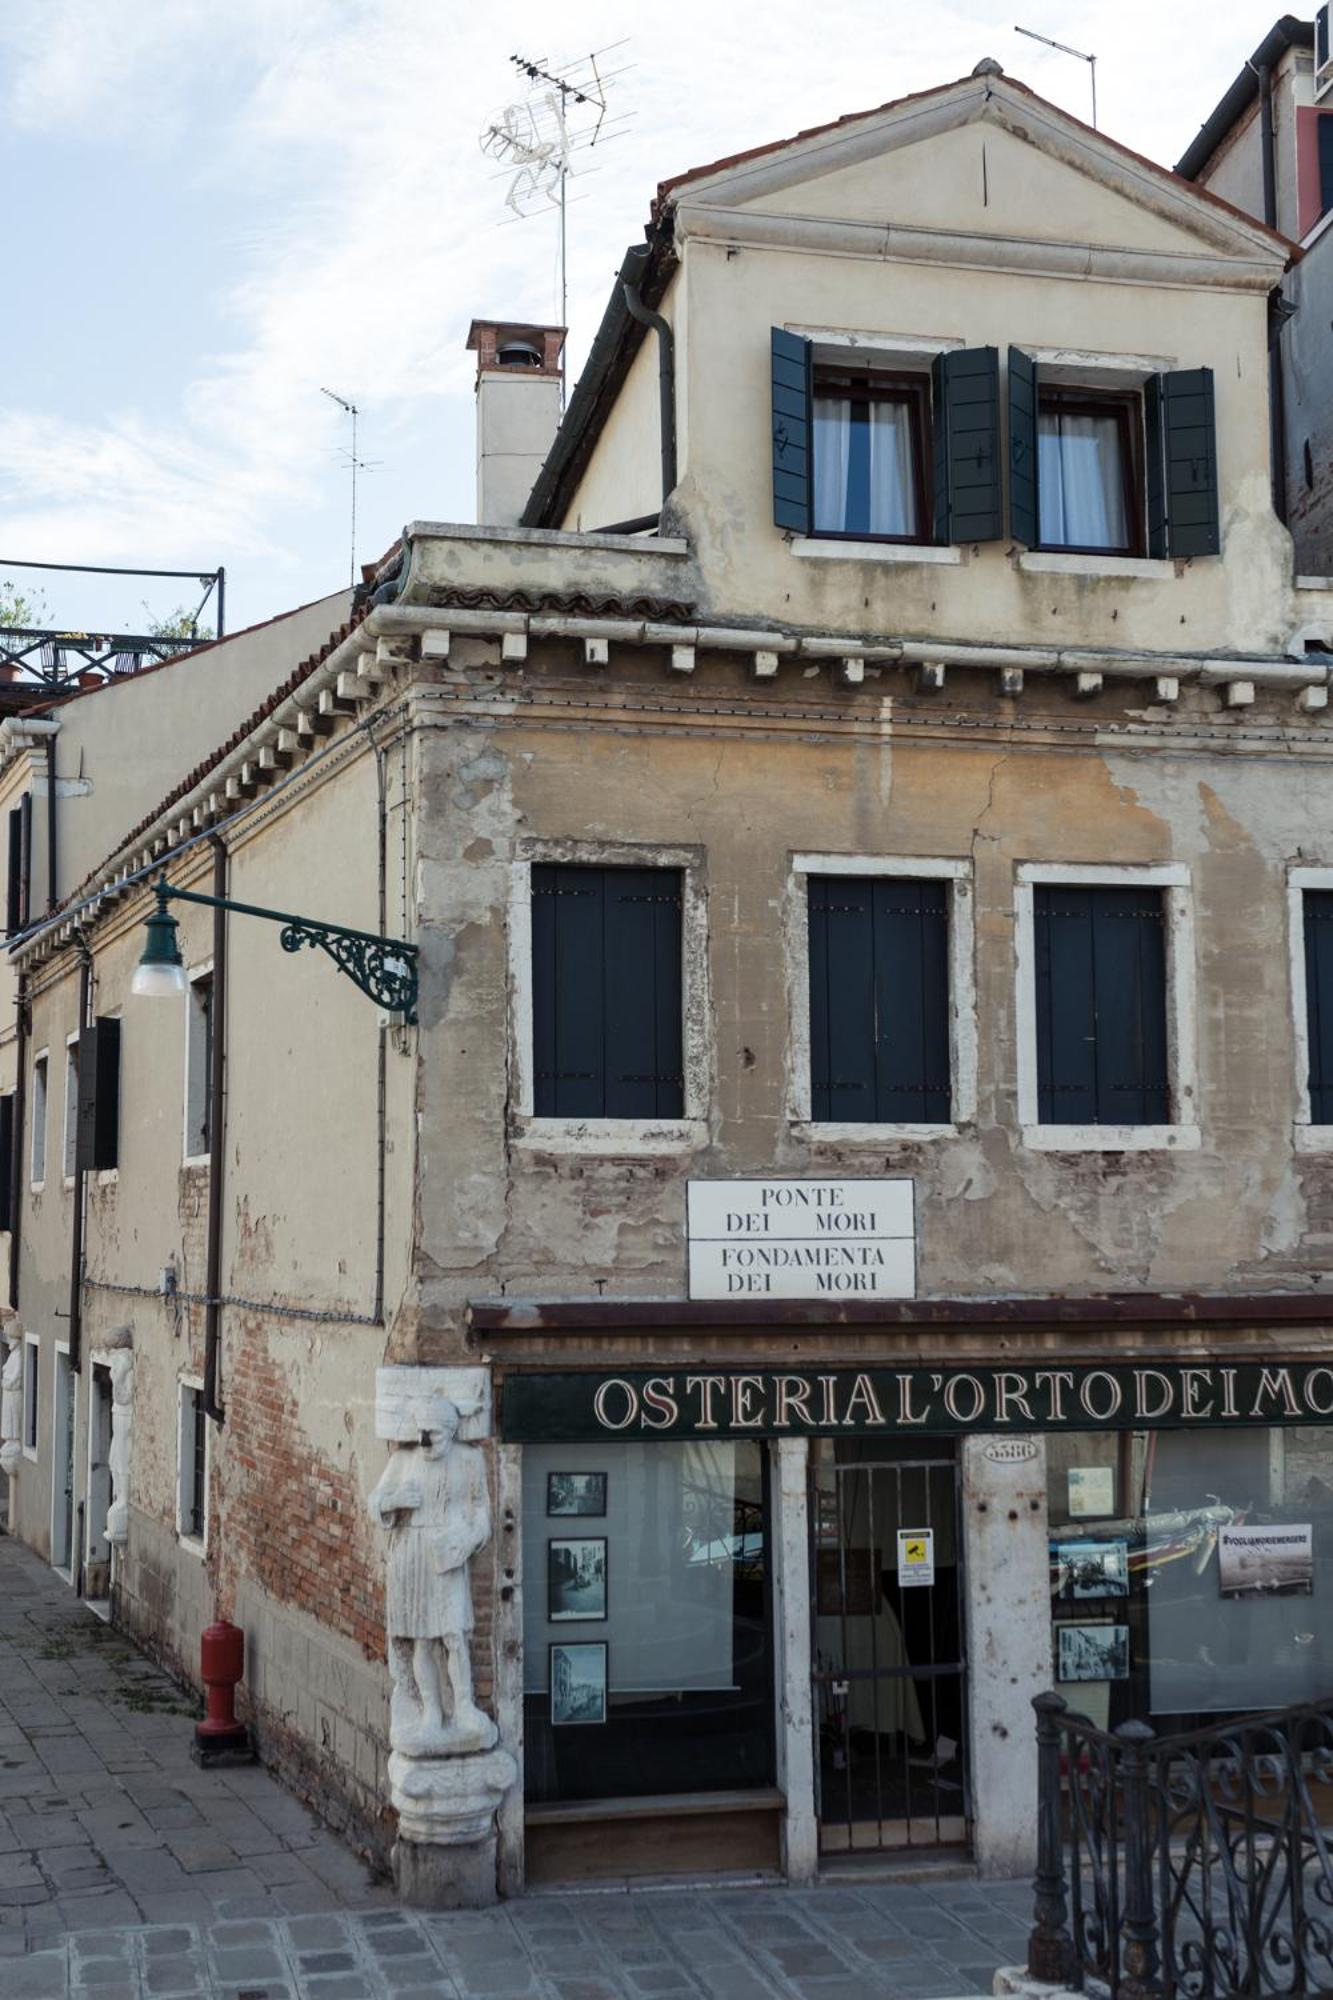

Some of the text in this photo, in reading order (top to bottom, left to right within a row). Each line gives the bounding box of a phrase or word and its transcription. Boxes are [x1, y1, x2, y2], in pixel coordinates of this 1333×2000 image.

[762, 1188, 843, 1207] PONTE
[727, 1213, 877, 1232] DEI MORI
[722, 1248, 885, 1267] FONDAMENTA
[728, 1273, 877, 1292] DEI MORI
[594, 1374, 885, 1430] OSTERIA
[896, 1372, 1123, 1425] L'ORTO
[1133, 1369, 1239, 1418] DEI
